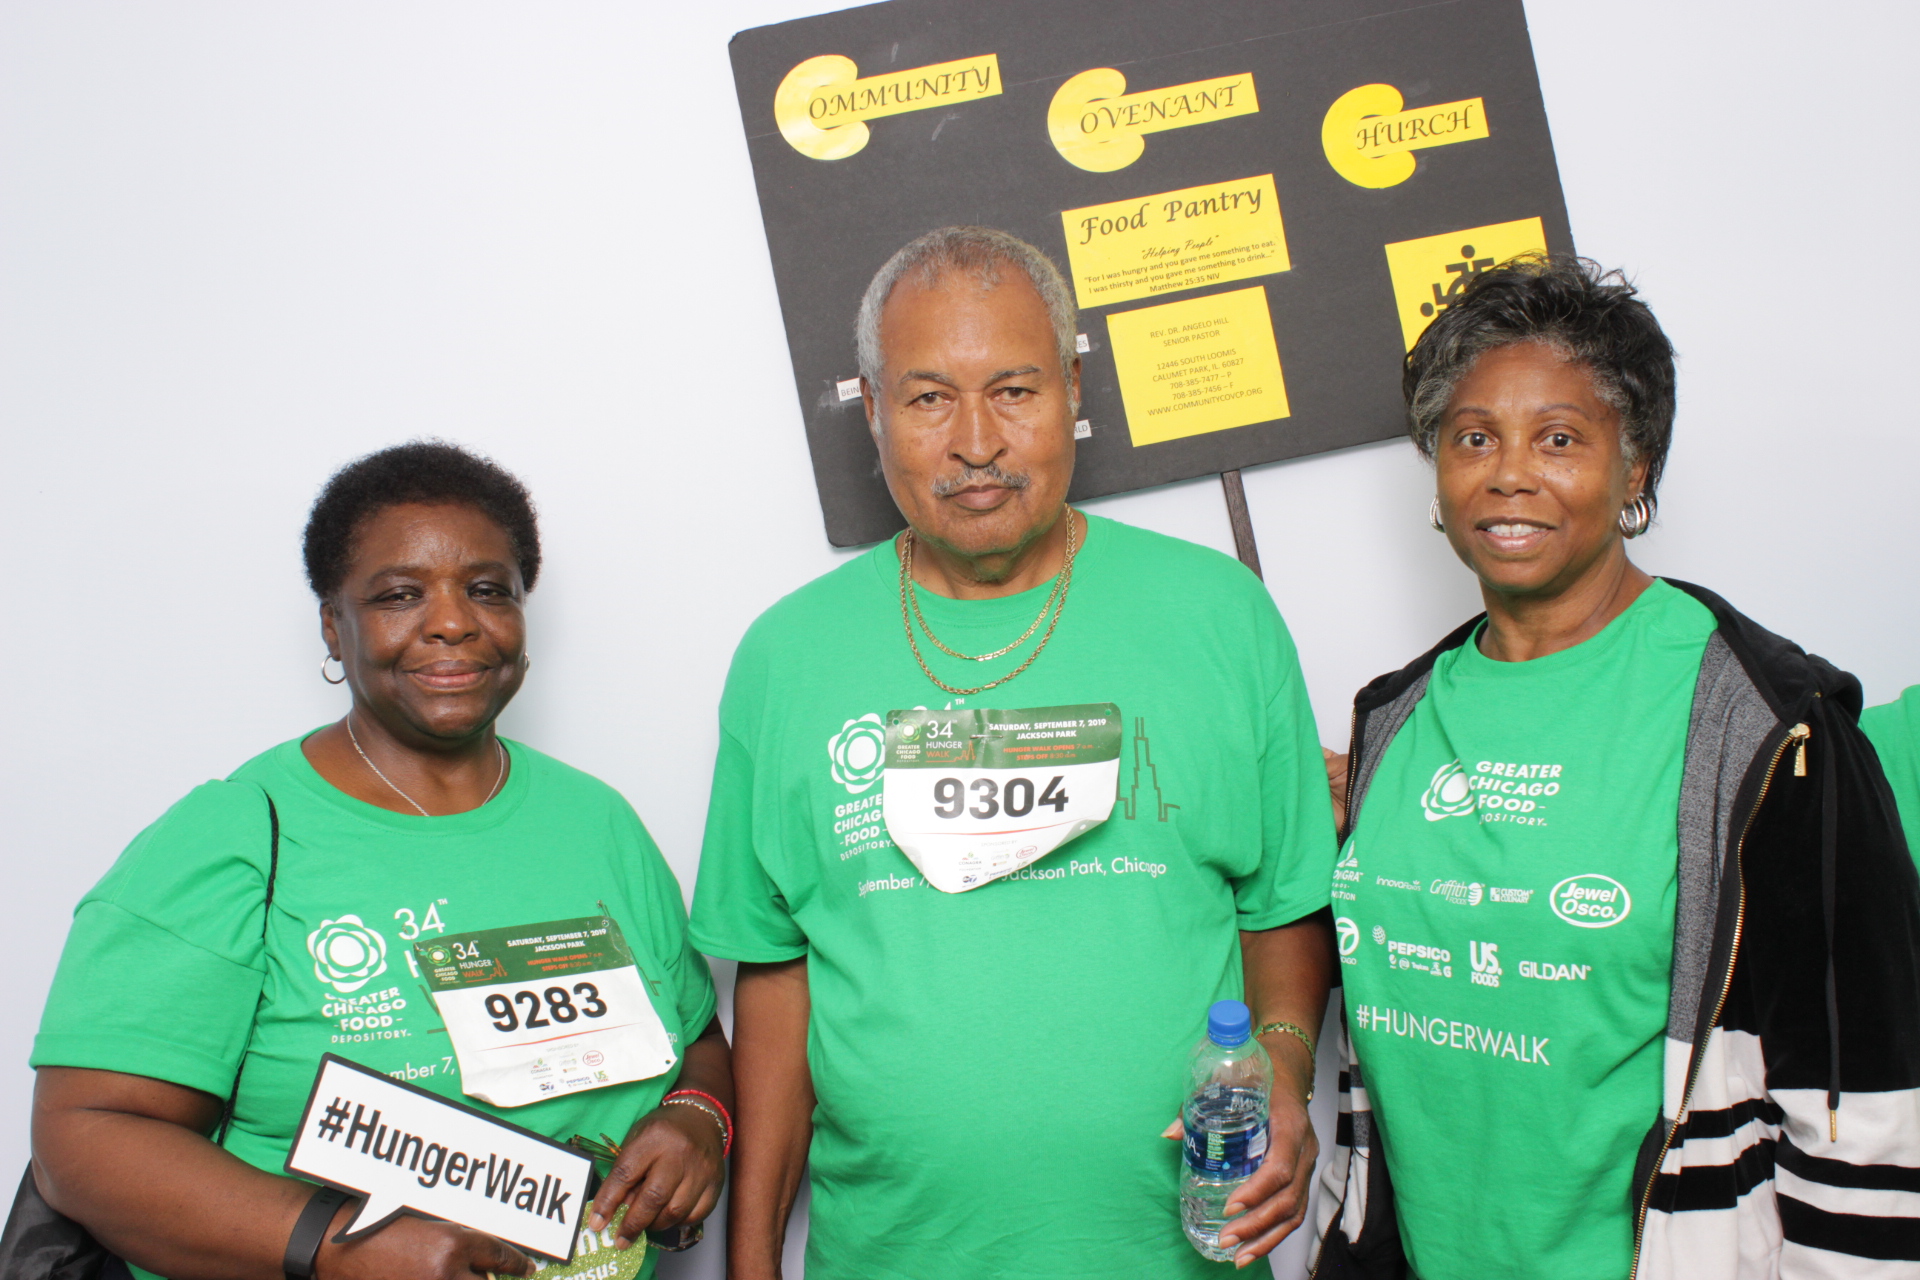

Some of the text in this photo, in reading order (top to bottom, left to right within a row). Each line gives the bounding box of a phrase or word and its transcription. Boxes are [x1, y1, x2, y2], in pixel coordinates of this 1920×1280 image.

[1080, 188, 1262, 245] Food Pantry
[1106, 272, 1121, 280] was
[1122, 265, 1148, 277] hungry
[1150, 261, 1164, 271] and
[1164, 259, 1179, 270] you
[1180, 256, 1197, 266] gave
[1212, 245, 1250, 259] something
[1093, 284, 1108, 293] was
[1109, 279, 1134, 290] thirsty
[1135, 275, 1149, 285] and
[1150, 273, 1165, 284] you
[1165, 270, 1183, 280] gave
[1184, 267, 1196, 275] me
[1198, 258, 1236, 272] something
[1237, 256, 1246, 264] to
[1149, 273, 1220, 293] Matthew 25:35 NIV
[1150, 316, 1229, 339] REV. DR. ANGELO HILL
[1163, 329, 1220, 347] SENIOR PASTOR
[1152, 369, 1187, 382] CALUMET
[1189, 365, 1211, 375] PARK,
[1221, 357, 1244, 368] 60827
[1156, 348, 1237, 371] 12446 SOUTH LOOMIS
[840, 386, 860, 397] BEIN
[988, 723, 1032, 731] SATURDAY,
[1034, 720, 1077, 730] SEPTEMBER
[1088, 718, 1107, 726] 2019
[926, 741, 962, 749] HUNGER
[1016, 730, 1077, 740] JACKSON PARK
[1476, 761, 1562, 778] GREATER
[1468, 775, 1560, 796] CHICAGO
[834, 793, 883, 818] GREATE
[933, 775, 1069, 820] 9304
[1478, 794, 1536, 812] FOOD
[833, 809, 883, 834] CHICAG
[844, 825, 880, 847] FOOD
[1070, 857, 1107, 876] Park,
[1111, 856, 1167, 878] Chicago
[1559, 882, 1619, 903] Jewel
[545, 931, 583, 943] SEPTEMBER
[590, 928, 607, 937] 2019
[535, 940, 586, 952] JACKSON PARK
[1387, 940, 1451, 963] PEPSICO
[459, 959, 492, 969] HUNGER
[462, 969, 485, 978] WALK
[1470, 971, 1500, 988] FOODS
[321, 998, 407, 1018] CHICAGO
[484, 981, 608, 1034] 9283
[340, 1015, 393, 1031] FOOD
[331, 1029, 408, 1043] DEPOSITORY
[1356, 1003, 1551, 1066] #HUNGERWALK
[441, 1056, 455, 1075] 7,
[317, 1096, 572, 1225] #HungerWalk
[551, 1261, 618, 1280] nsus
